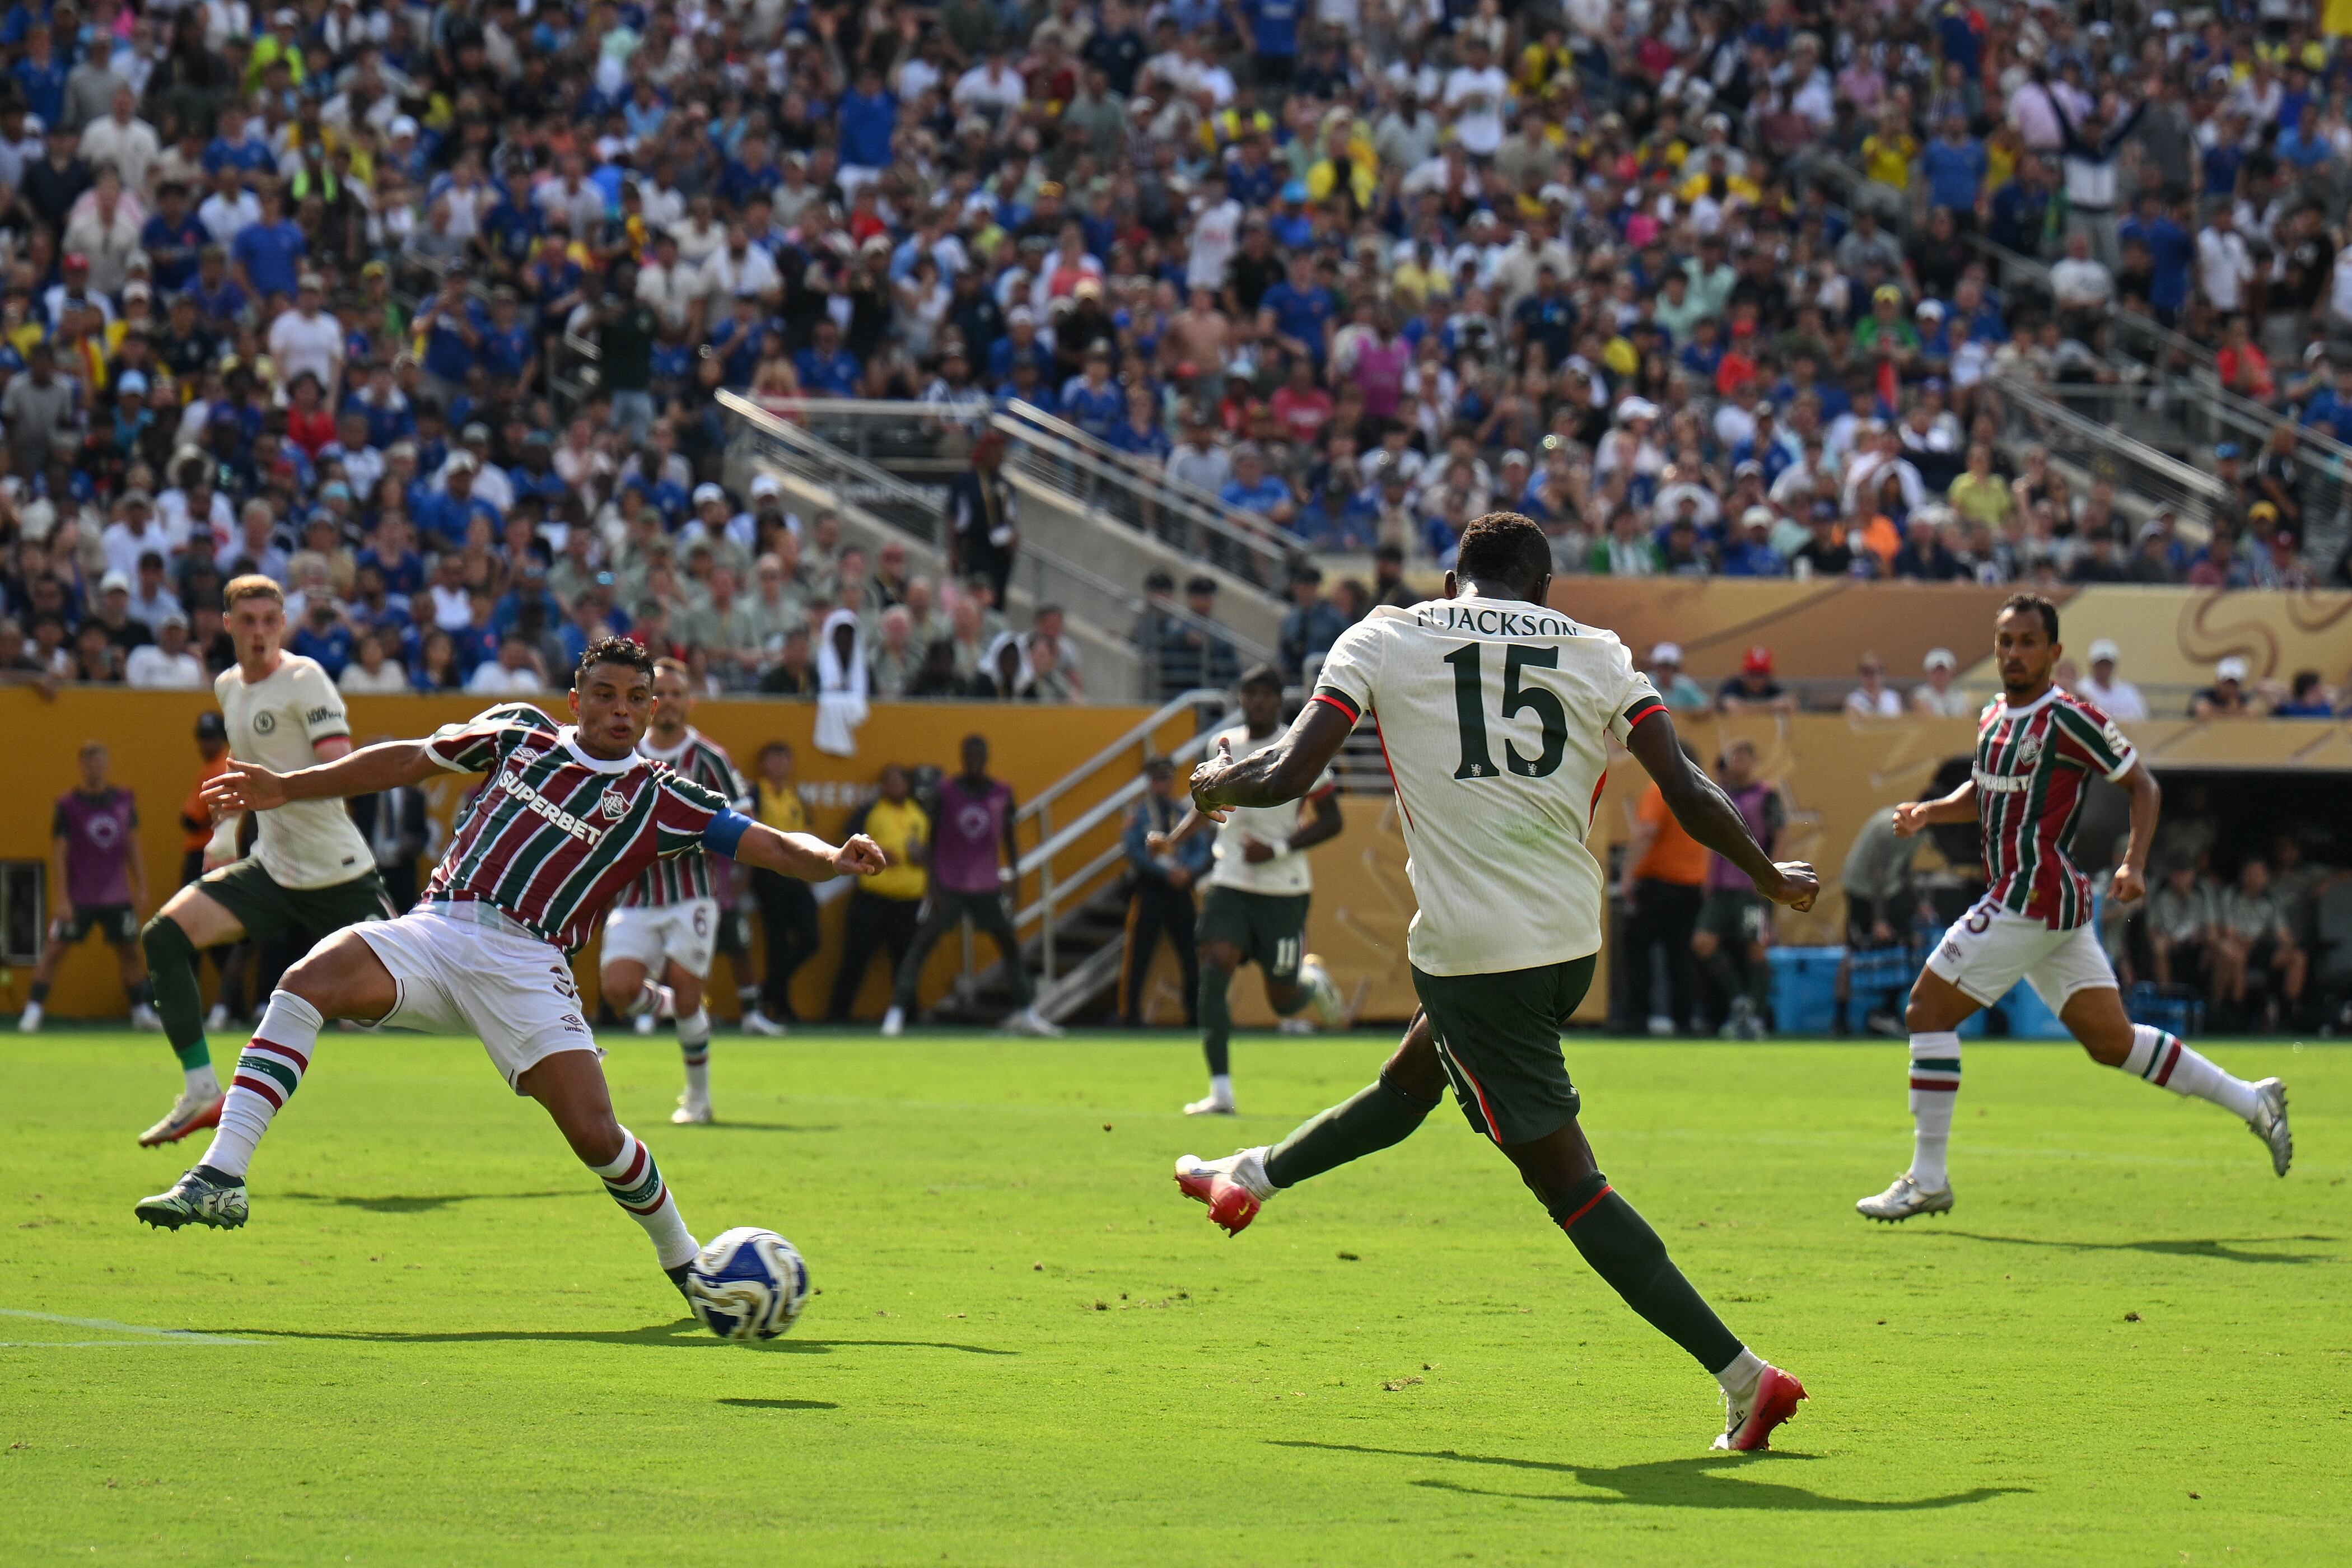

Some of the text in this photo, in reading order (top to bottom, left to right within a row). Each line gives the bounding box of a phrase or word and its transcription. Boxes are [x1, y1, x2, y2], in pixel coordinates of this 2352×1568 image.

[1444, 642, 1568, 780] 15
[498, 770, 601, 846] SUPERBET
[693, 906, 707, 938] 6
[1966, 902, 2001, 934] 5
[549, 965, 575, 1000] 3
